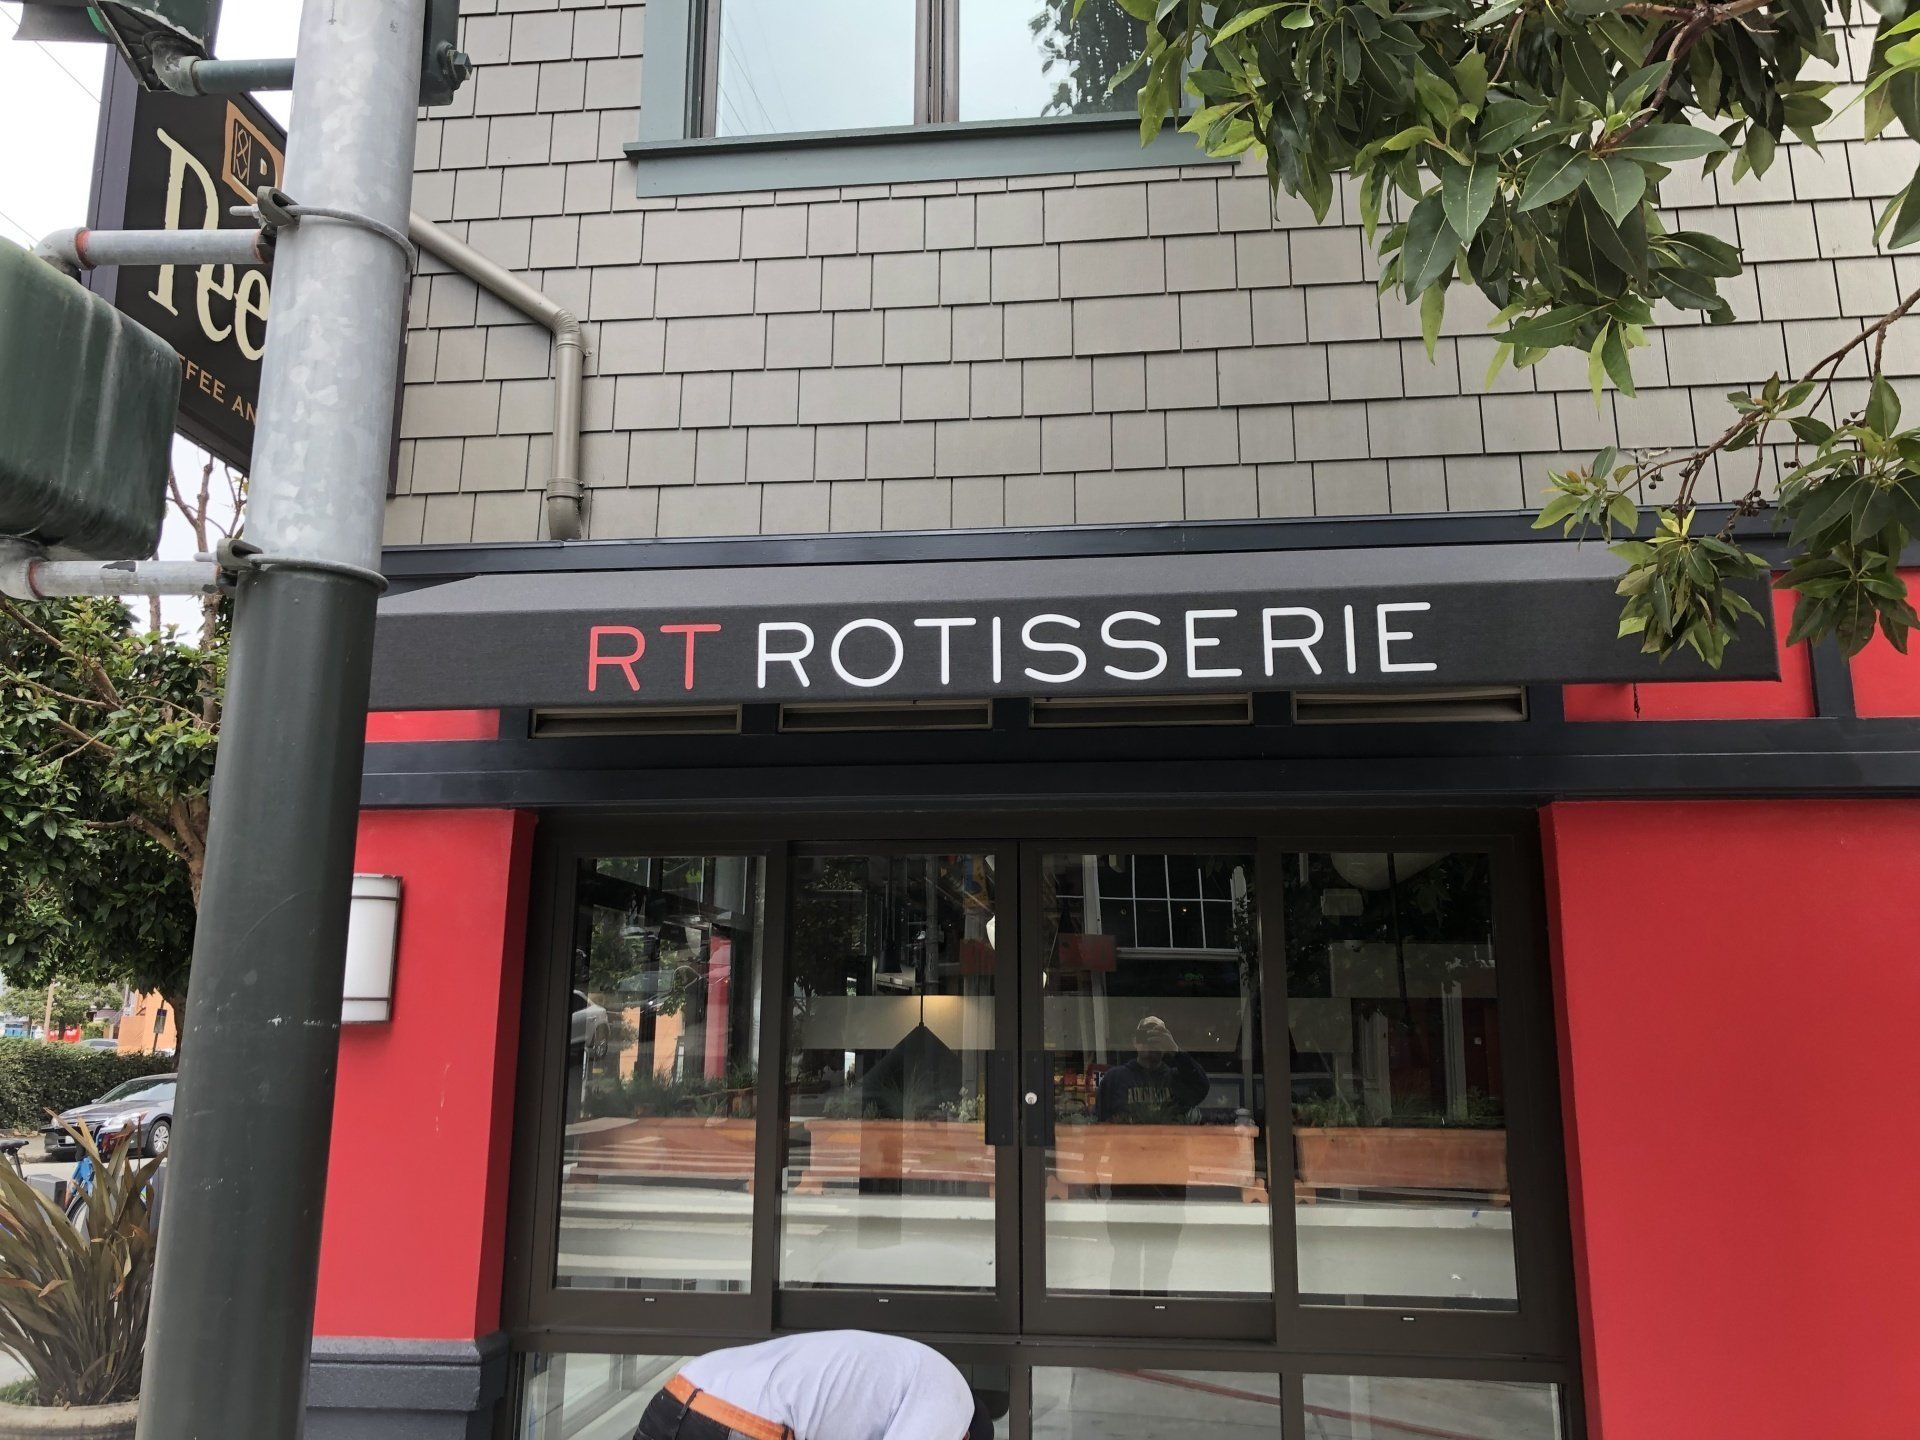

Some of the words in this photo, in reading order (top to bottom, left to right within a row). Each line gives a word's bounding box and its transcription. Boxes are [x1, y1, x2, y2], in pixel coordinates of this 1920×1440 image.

[149, 127, 271, 361] Pee
[231, 394, 258, 426] AN
[587, 622, 722, 692] RT
[756, 601, 1439, 690] ROTISSERIE
